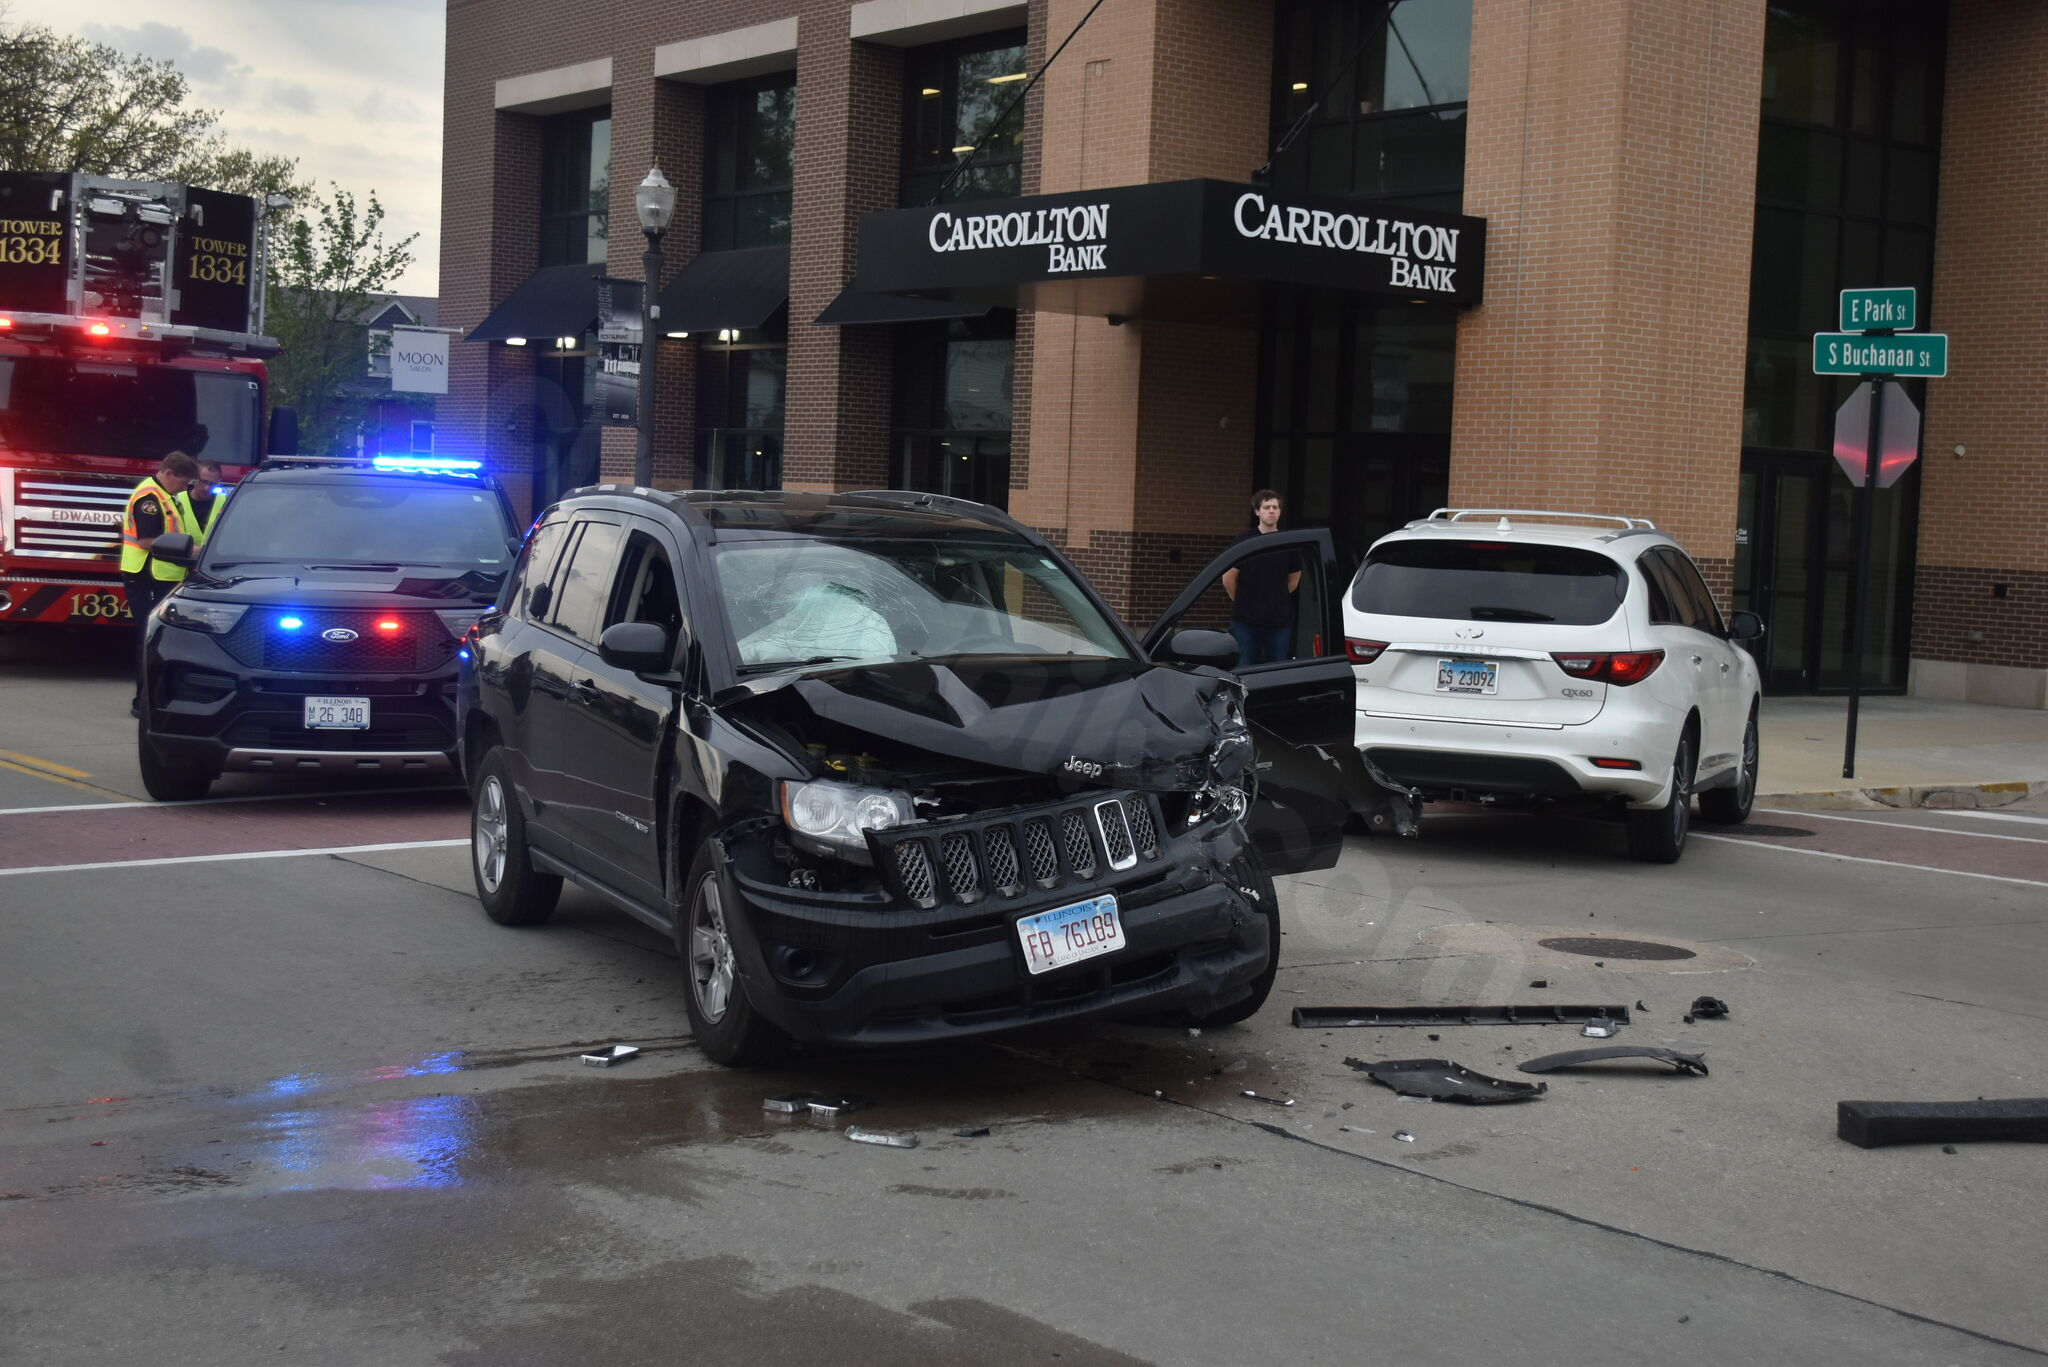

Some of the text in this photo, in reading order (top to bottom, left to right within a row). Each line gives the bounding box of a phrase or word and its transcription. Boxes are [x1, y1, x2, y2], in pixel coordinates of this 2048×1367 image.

[0, 219, 63, 235] TOWER
[929, 203, 1110, 253] CARROLLTON
[1234, 193, 1459, 263] CARROLLTON
[0, 237, 61, 265] 1334
[192, 236, 248, 257] TOWER
[1047, 244, 1107, 273] BANK
[189, 255, 247, 286] 1334
[1389, 257, 1457, 293] BANK
[1852, 299, 1906, 322] E Park St
[398, 352, 444, 366] MOON
[1829, 342, 1931, 367] S Buchanan St
[52, 509, 125, 523] EDWARDS
[71, 593, 133, 618] 1334
[1439, 668, 1495, 687] CS 23092
[1561, 688, 1593, 698] QX60
[320, 707, 334, 723] 26
[341, 708, 363, 723] 348
[1063, 755, 1103, 779] Jeep
[1043, 904, 1092, 923] ILLINOIS
[1027, 912, 1117, 962] FB 76189
